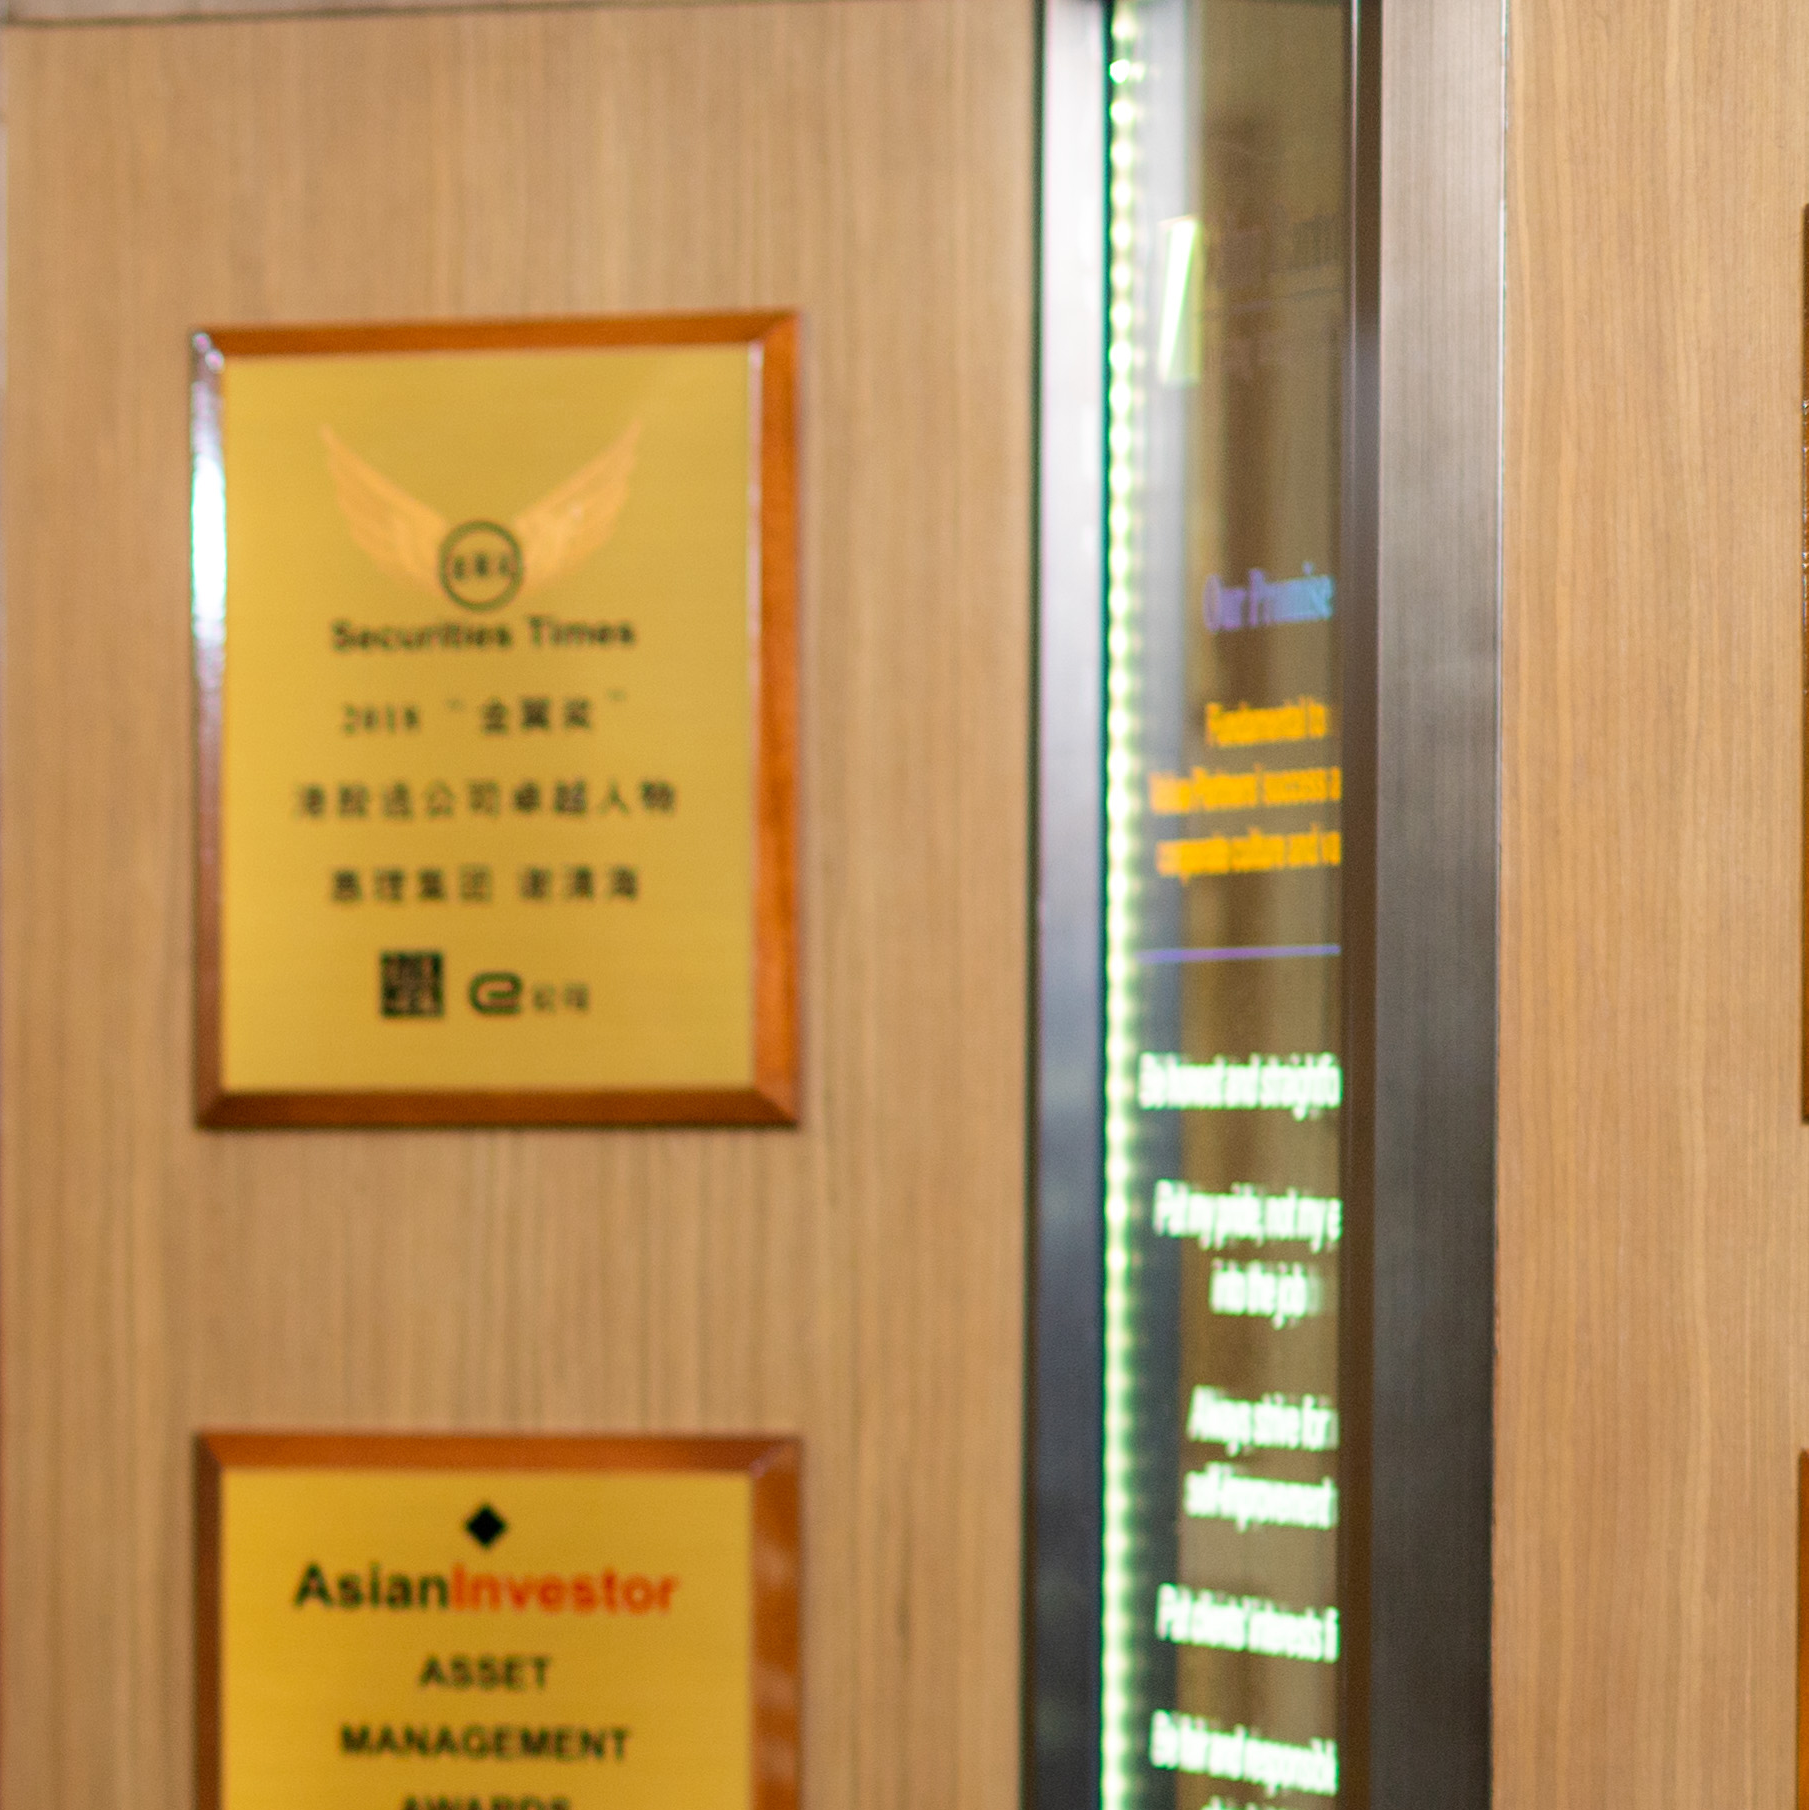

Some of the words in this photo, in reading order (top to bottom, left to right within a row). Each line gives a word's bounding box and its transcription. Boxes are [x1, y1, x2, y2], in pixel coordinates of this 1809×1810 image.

[332, 619, 512, 652] Securities
[526, 614, 636, 649] Times
[294, 1562, 679, 1616] AsianInvestor
[420, 1655, 552, 1691] ASSET
[340, 1724, 630, 1762] MANAGEMENT
